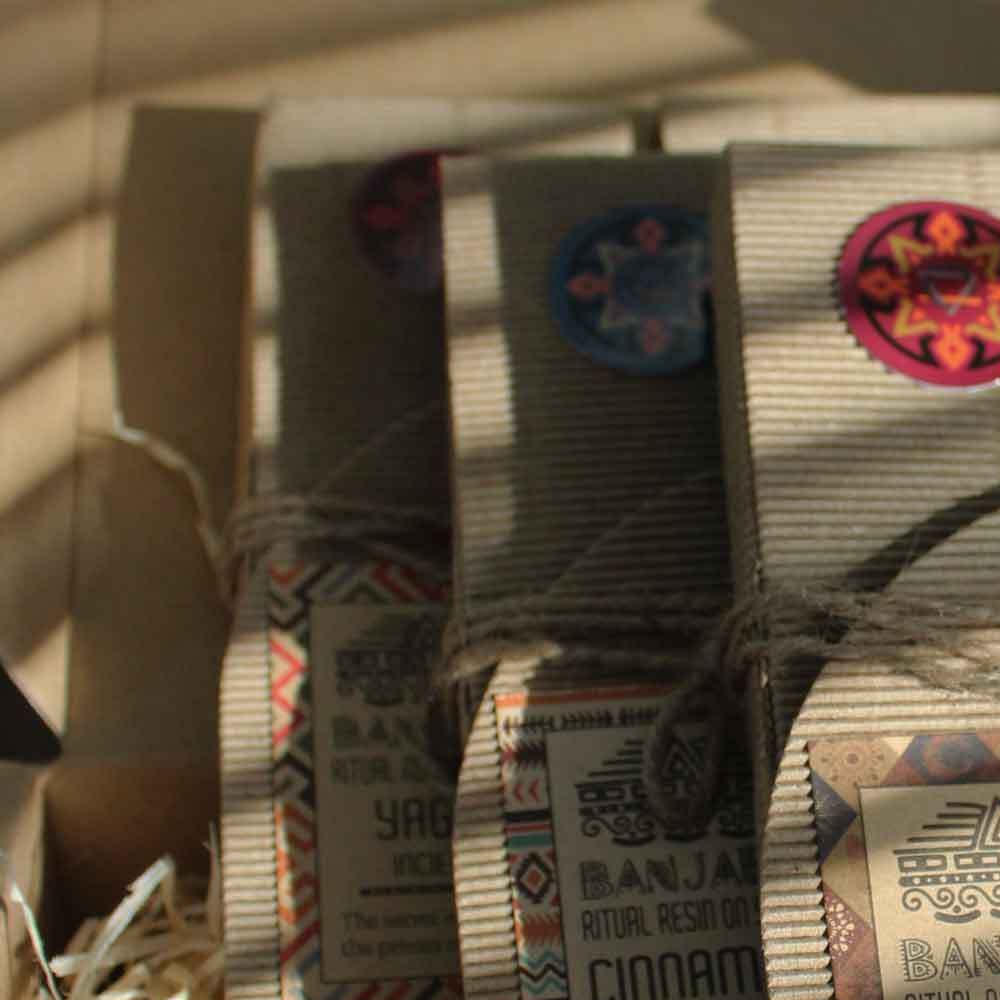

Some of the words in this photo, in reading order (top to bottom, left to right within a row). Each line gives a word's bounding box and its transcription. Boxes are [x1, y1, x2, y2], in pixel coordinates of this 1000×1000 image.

[581, 906, 653, 942] RITUAL
[656, 898, 717, 935] RESIN
[720, 896, 750, 930] ON
